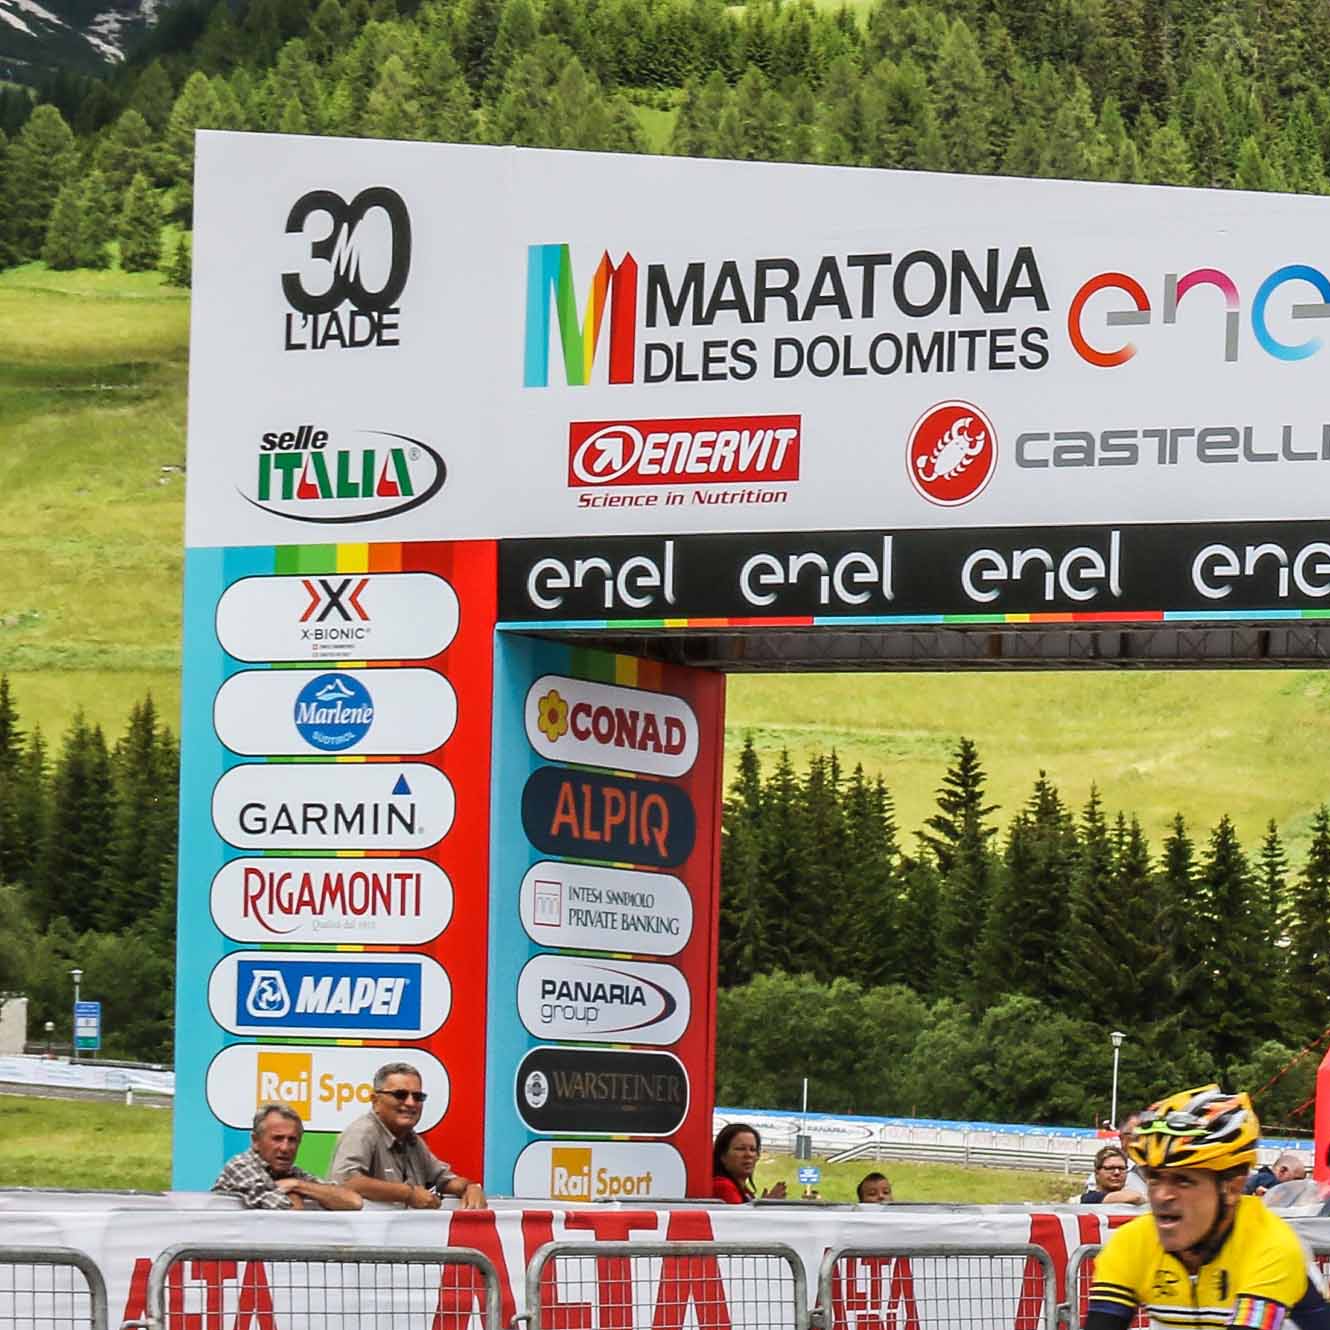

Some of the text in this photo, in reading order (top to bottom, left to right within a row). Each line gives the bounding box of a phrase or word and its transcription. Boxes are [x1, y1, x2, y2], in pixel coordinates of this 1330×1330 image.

[281, 186, 411, 314] 30
[645, 246, 1049, 328] MARATONA
[285, 307, 400, 351] L'IADE
[643, 326, 1049, 383] DLES DOLOMITES
[260, 426, 328, 451] selle
[638, 427, 796, 475] ENERVIT
[258, 447, 414, 501] ITALIA
[578, 488, 787, 509] Science in Nutrition
[527, 541, 676, 609] enel
[739, 536, 894, 606] enel
[961, 530, 1123, 602] enel
[301, 628, 365, 640] X-BIONIC
[296, 701, 373, 724] Marlene
[571, 703, 686, 755] CONAD
[239, 803, 415, 834] GARMIN
[550, 782, 670, 858] ALPIQ
[243, 867, 422, 930] RIGAMONTI
[569, 886, 603, 904] INTESA
[568, 908, 680, 936] PRIVATE BANKING
[295, 976, 407, 1015] MAPEI
[541, 979, 646, 1006] PANARIA
[540, 1003, 598, 1025] group
[260, 1071, 376, 1112] Rai Spo
[553, 1071, 681, 1103] WARSTEINER
[554, 1167, 653, 1197] Rai Sport
